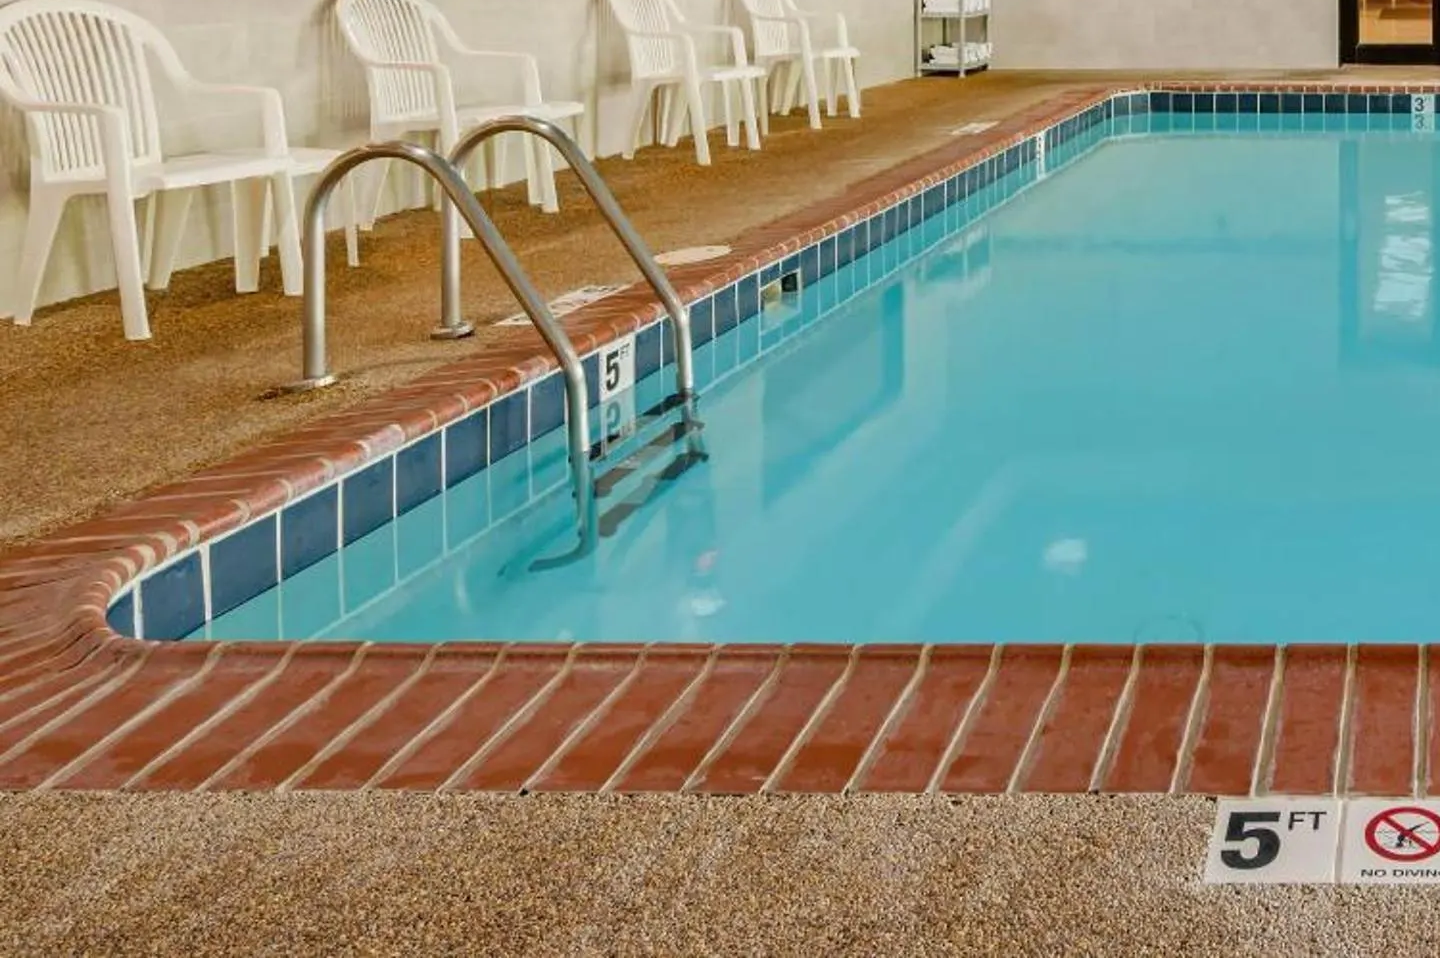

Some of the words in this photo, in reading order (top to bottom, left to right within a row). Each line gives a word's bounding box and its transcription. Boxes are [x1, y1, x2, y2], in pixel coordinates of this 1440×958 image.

[1414, 97, 1425, 112] 3
[606, 349, 620, 391] 5
[1220, 811, 1282, 870] 5
[1288, 811, 1327, 831] FT
[1360, 869, 1387, 878] NO
